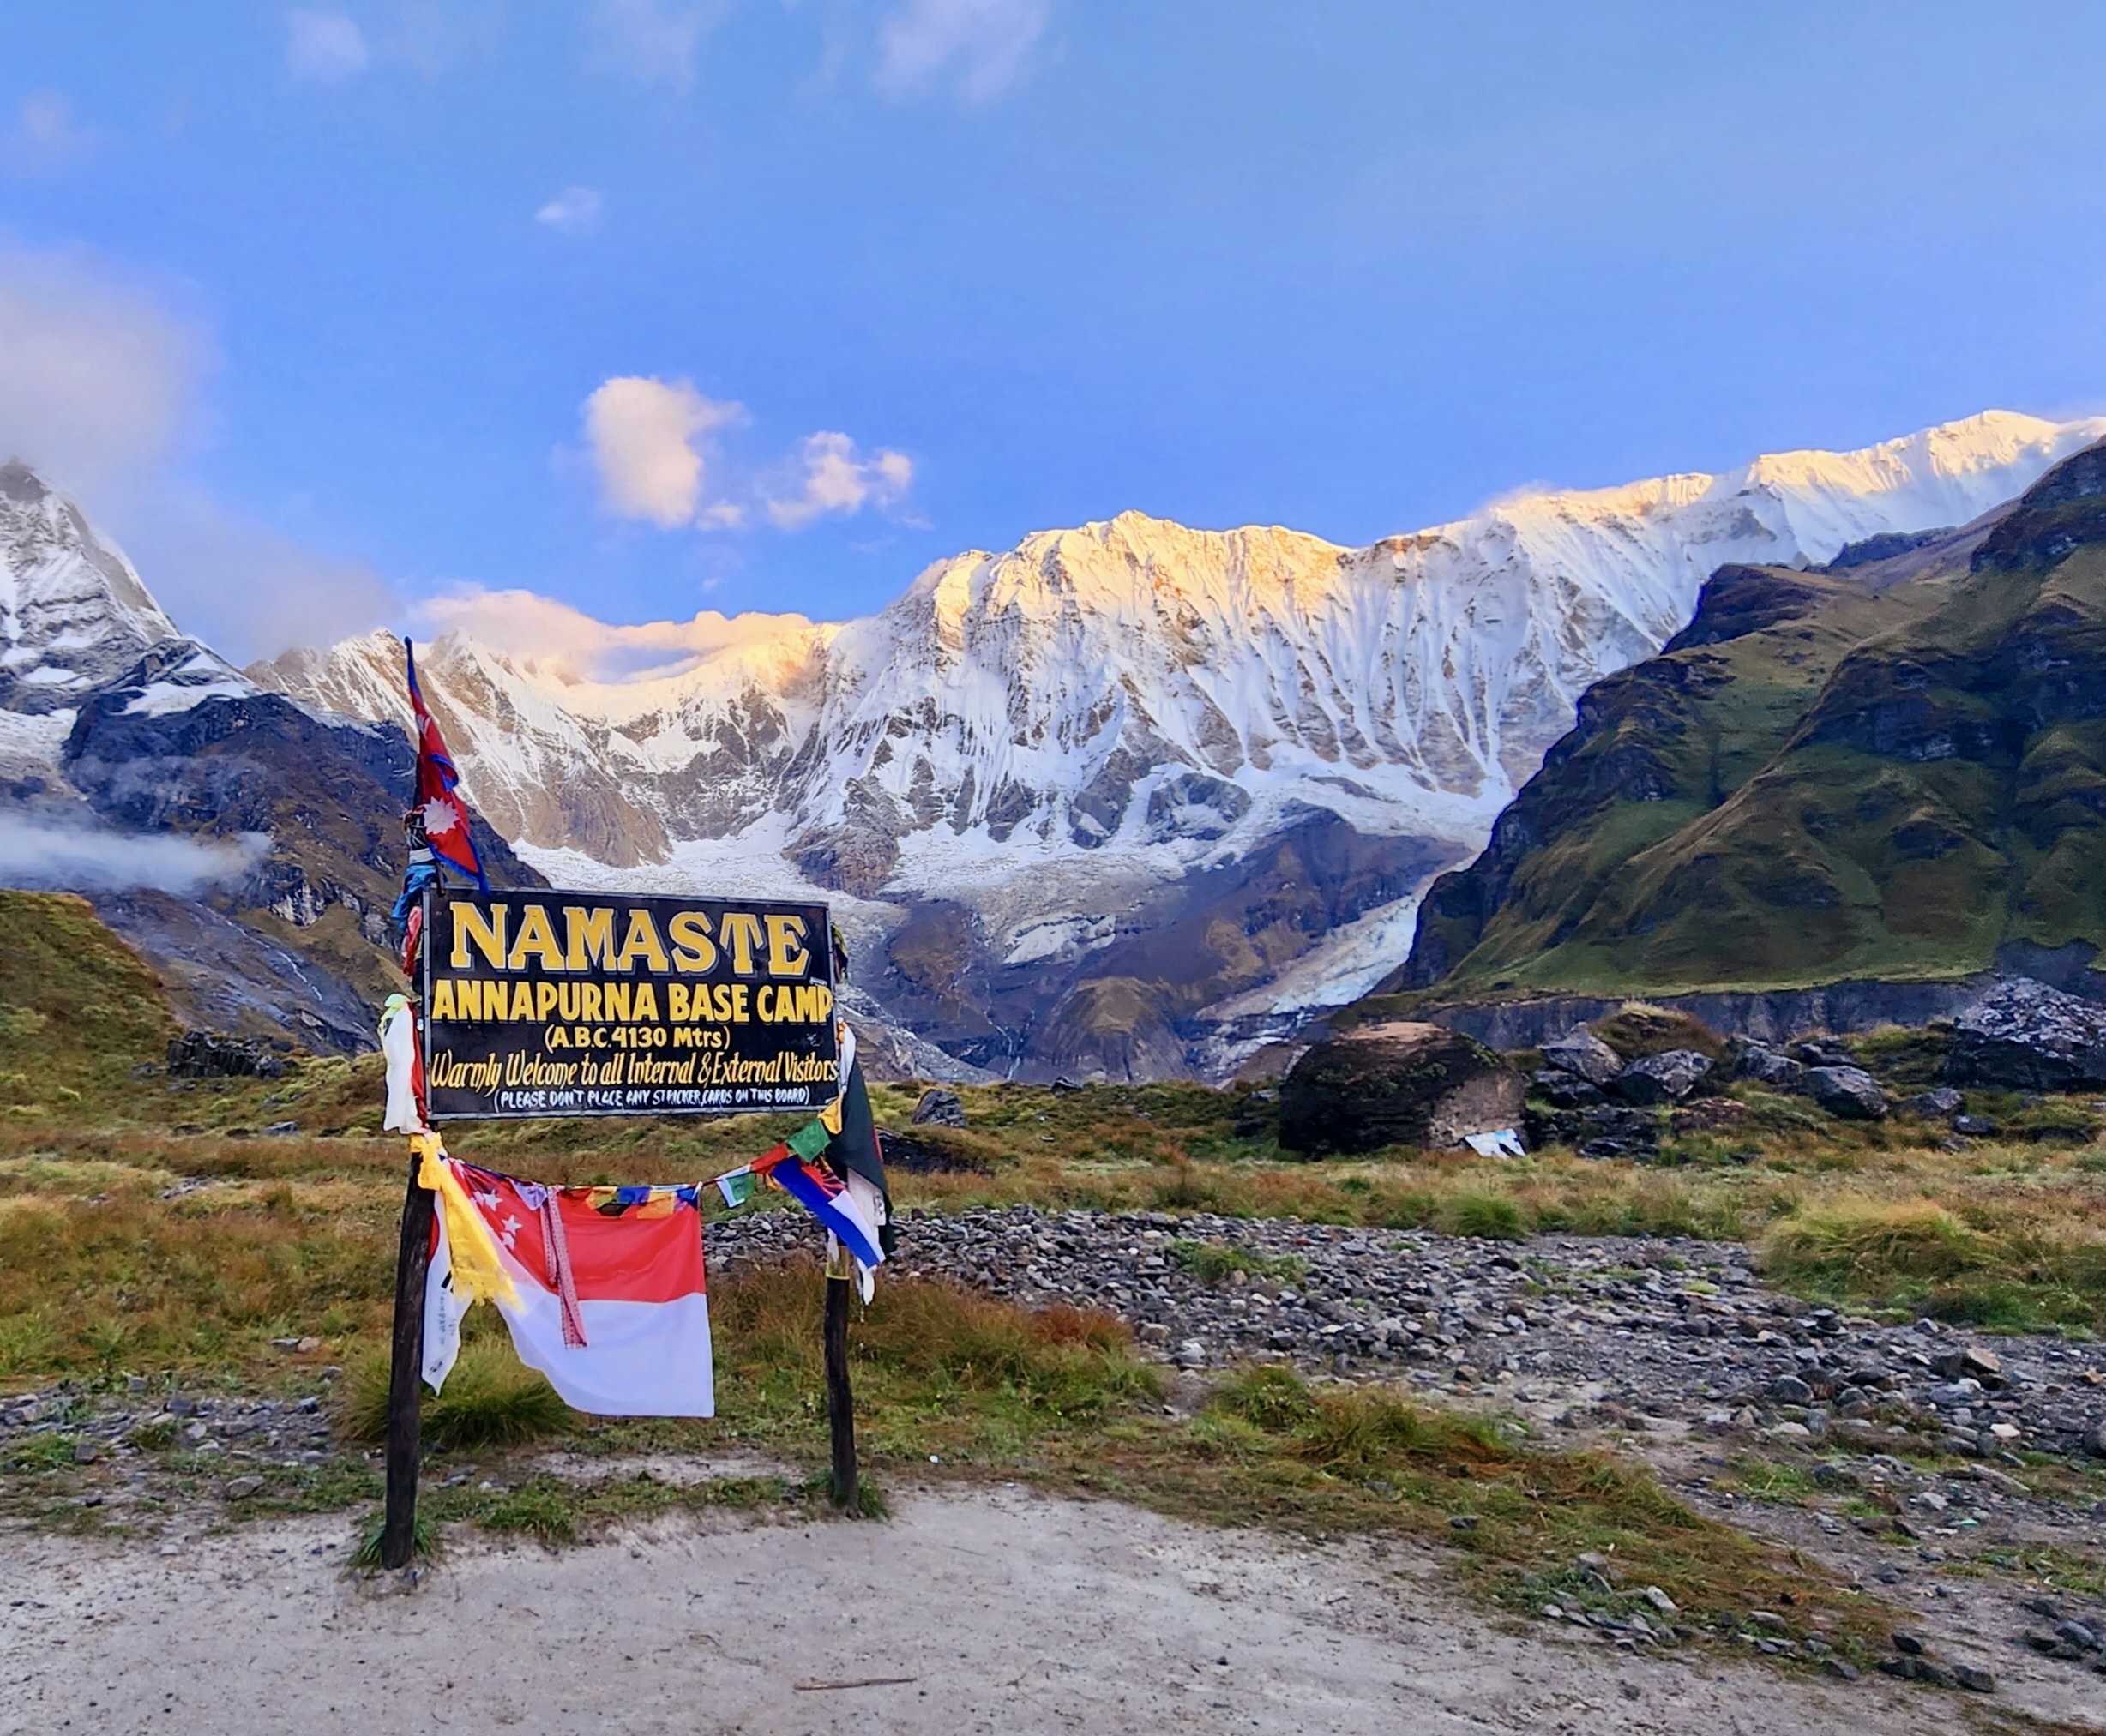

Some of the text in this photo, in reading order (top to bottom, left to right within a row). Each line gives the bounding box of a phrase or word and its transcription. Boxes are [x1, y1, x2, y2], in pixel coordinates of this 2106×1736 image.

[450, 902, 809, 976] NAMASTE
[432, 979, 833, 1023] ANNAPURNA BASE CAMP
[672, 1025, 731, 1050] Mtrs)
[431, 1048, 502, 1097] Warmly
[505, 1048, 578, 1090] Welcome
[581, 1052, 598, 1086] to
[600, 1051, 626, 1085] all
[627, 1051, 697, 1087] Internal
[784, 1050, 839, 1083] Visitors
[493, 1089, 546, 1113] (PLEASE
[549, 1088, 585, 1108] DON'T
[587, 1090, 623, 1109] PLACE
[626, 1089, 651, 1107] ANY
[735, 1088, 749, 1104] ON
[749, 1087, 773, 1103] THIS
[774, 1085, 810, 1106] BOARD)
